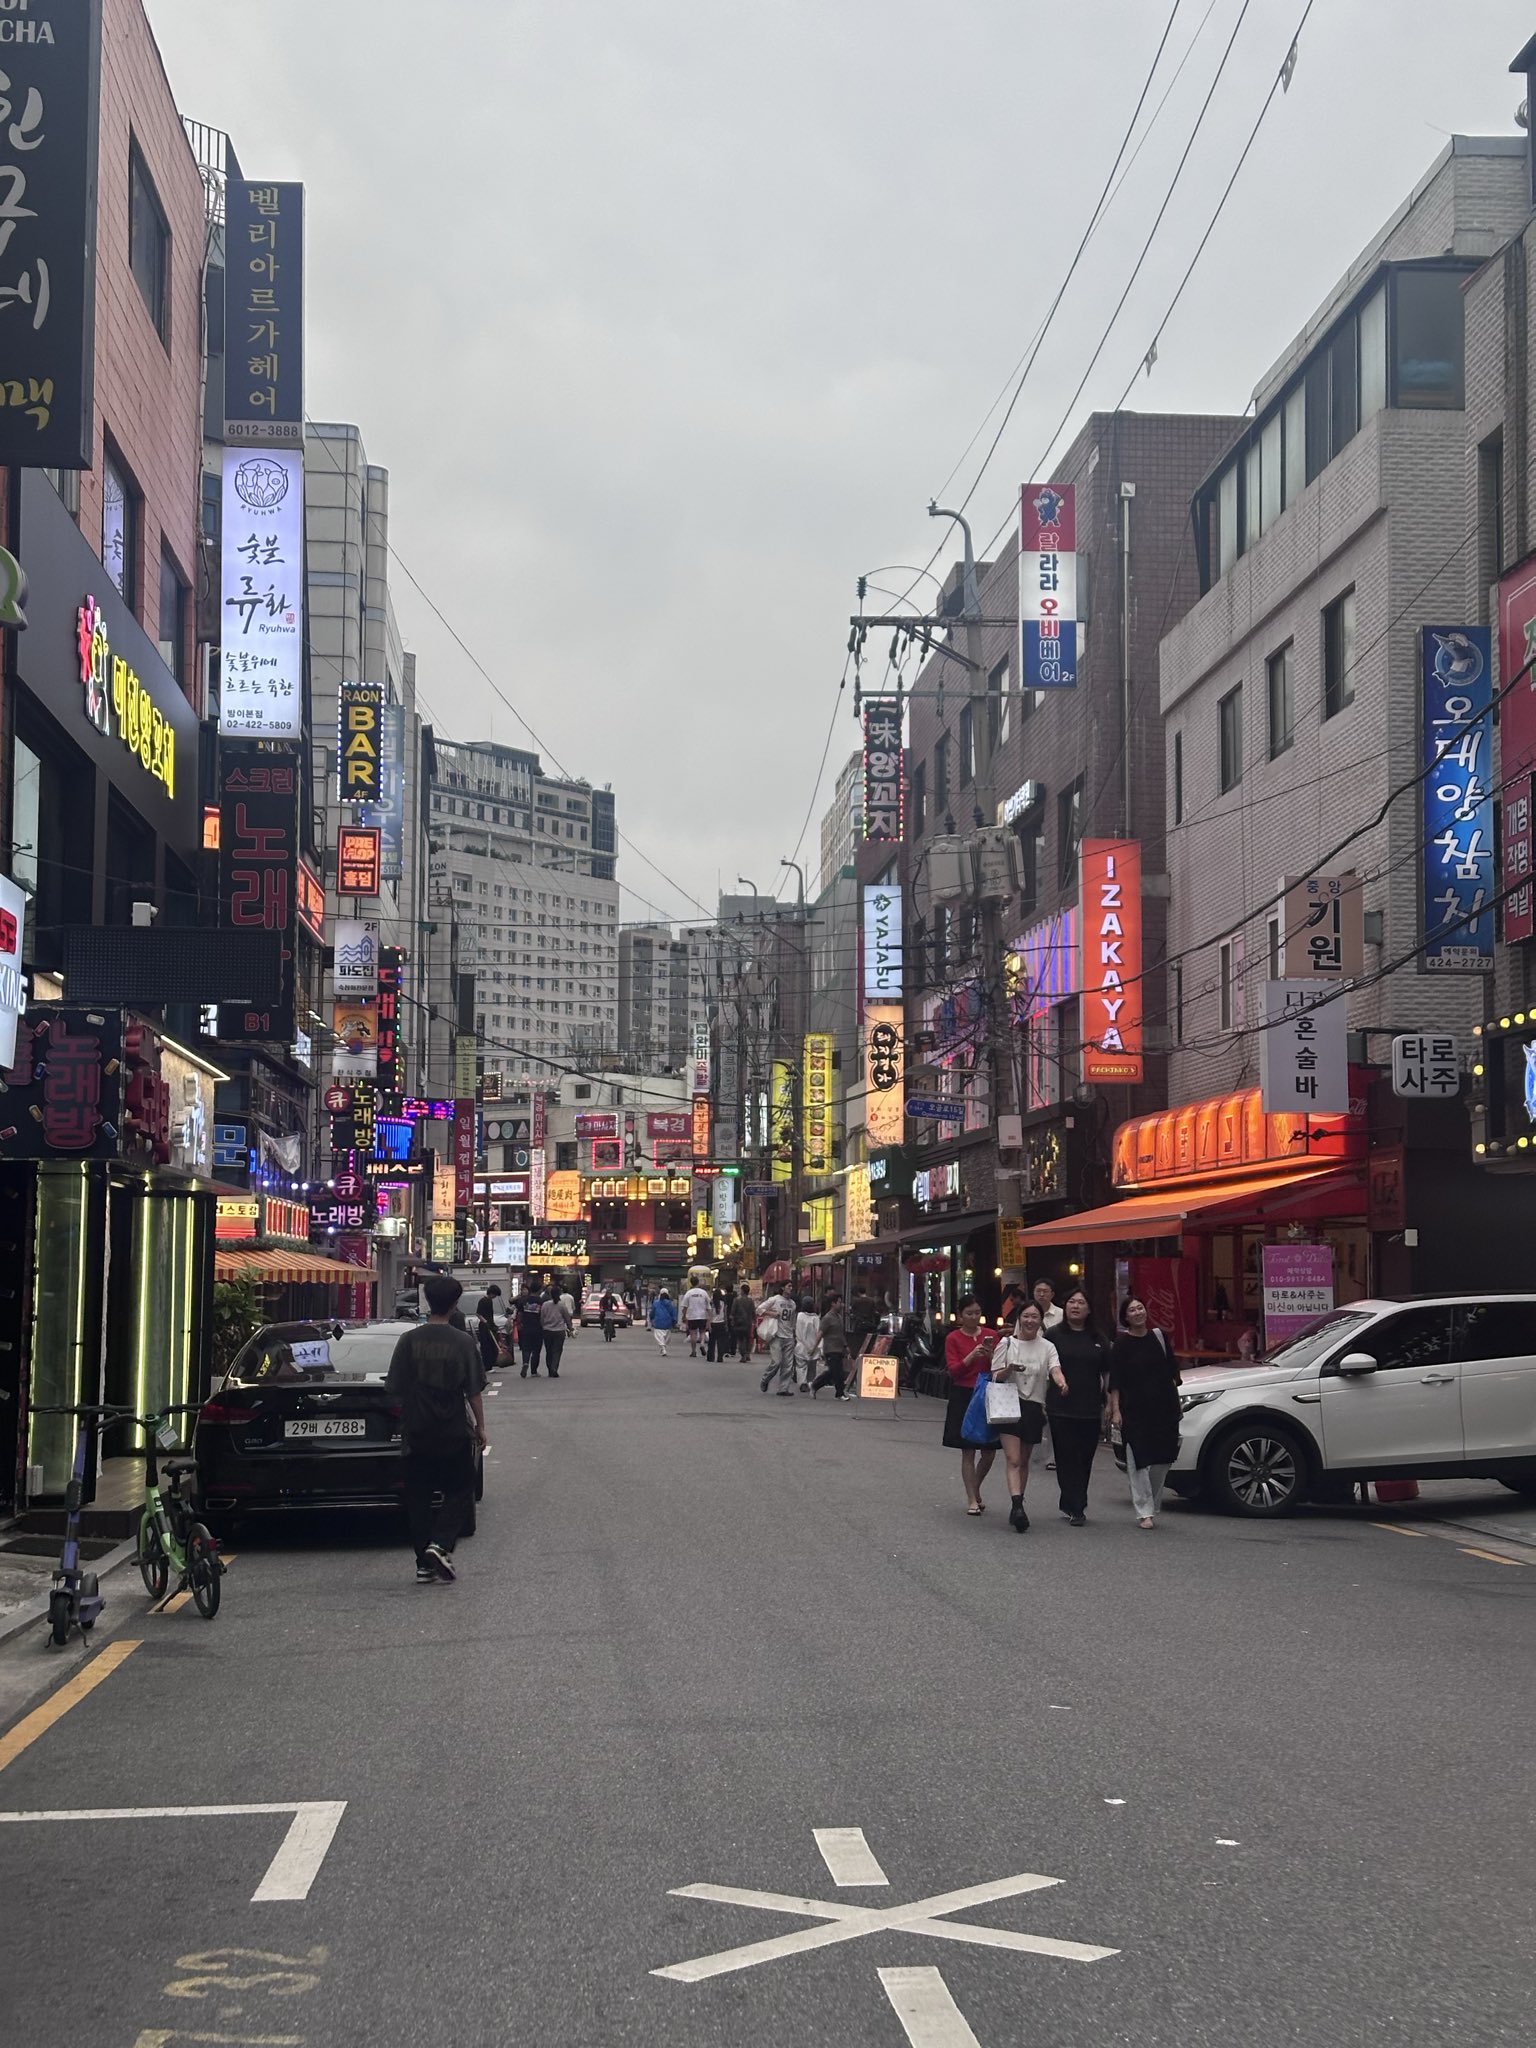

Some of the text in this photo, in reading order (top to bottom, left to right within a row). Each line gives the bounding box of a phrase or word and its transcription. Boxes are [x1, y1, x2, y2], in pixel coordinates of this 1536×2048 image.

[247, 187, 281, 416] 벨리아르가헤어
[228, 423, 299, 438] 6012-3888
[240, 504, 282, 516] RYUHWA
[237, 533, 285, 565] 숯불
[226, 575, 292, 634] 류화
[259, 623, 296, 635] Ryuhwa
[1039, 598, 1061, 682] 오비베어
[225, 651, 278, 673] 숯불위에
[226, 677, 264, 695] 흐르는
[1062, 671, 1075, 683] 2F
[343, 689, 379, 703] RAON
[227, 709, 263, 719] 방이본점
[226, 720, 292, 730] 02-422-5809
[345, 706, 377, 785] BAR
[225, 767, 294, 794] 스크린
[353, 790, 369, 799] 4F
[1432, 696, 1491, 934] 오대양참치
[231, 803, 290, 945] 노래
[343, 870, 373, 887] 홀덤
[1306, 880, 1341, 894] 중앙
[364, 922, 378, 932] 2F
[1307, 898, 1343, 972] 기원
[875, 914, 889, 990] YAJASU
[1100, 856, 1124, 1050] IZAKAYA
[1429, 957, 1492, 969] 424-2727
[244, 1013, 271, 1032] B1
[1294, 1016, 1320, 1099] 혼술바
[1402, 1037, 1457, 1064] 타로
[44, 1019, 103, 1150] 노래방
[1401, 1066, 1458, 1094] 사주
[330, 1091, 348, 1108] 큐
[353, 1088, 373, 1147] 노래방
[652, 1117, 685, 1132] 북경
[337, 1175, 361, 1196] 큐
[311, 1204, 365, 1227] 노래방
[1271, 1290, 1326, 1300] 타로&사주는
[1267, 1301, 1329, 1313] 미신이 아닙니다
[324, 1420, 359, 1435] 6788
